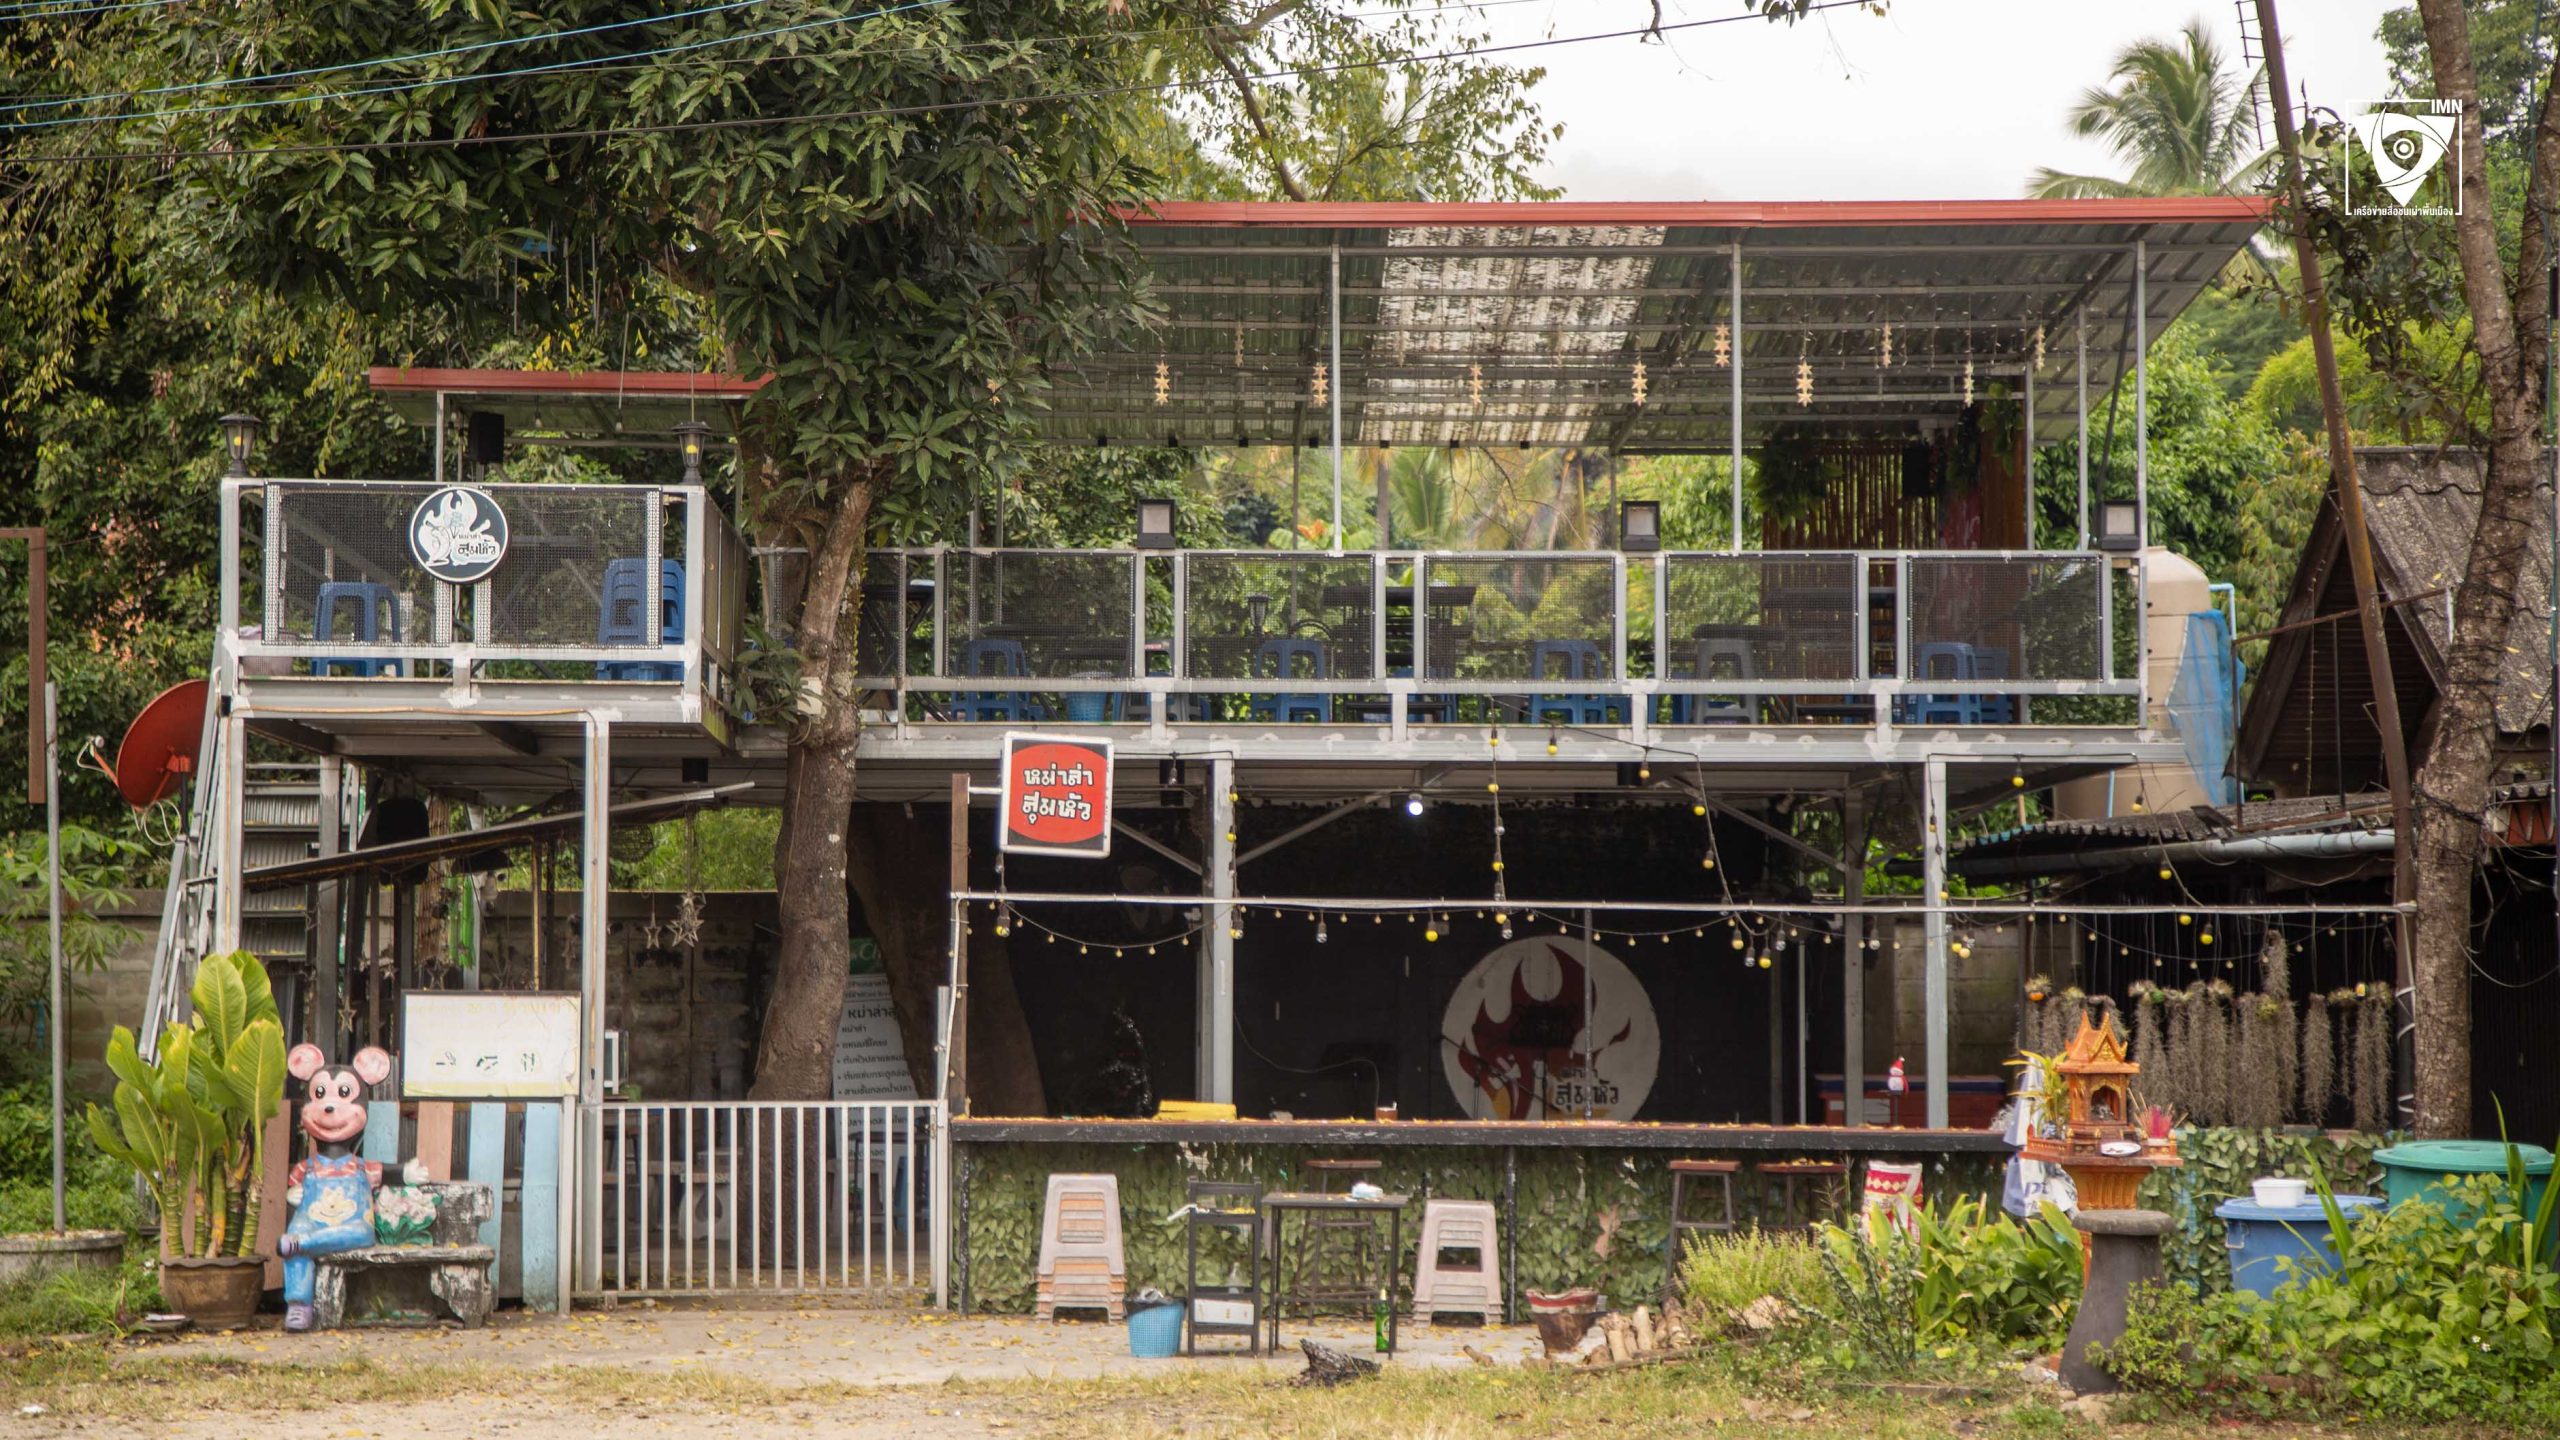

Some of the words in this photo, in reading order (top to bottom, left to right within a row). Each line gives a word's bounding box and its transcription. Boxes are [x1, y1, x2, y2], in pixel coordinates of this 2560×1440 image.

[1023, 762, 1094, 786] หม่าล่า
[1022, 790, 1092, 825] สุมหัว
